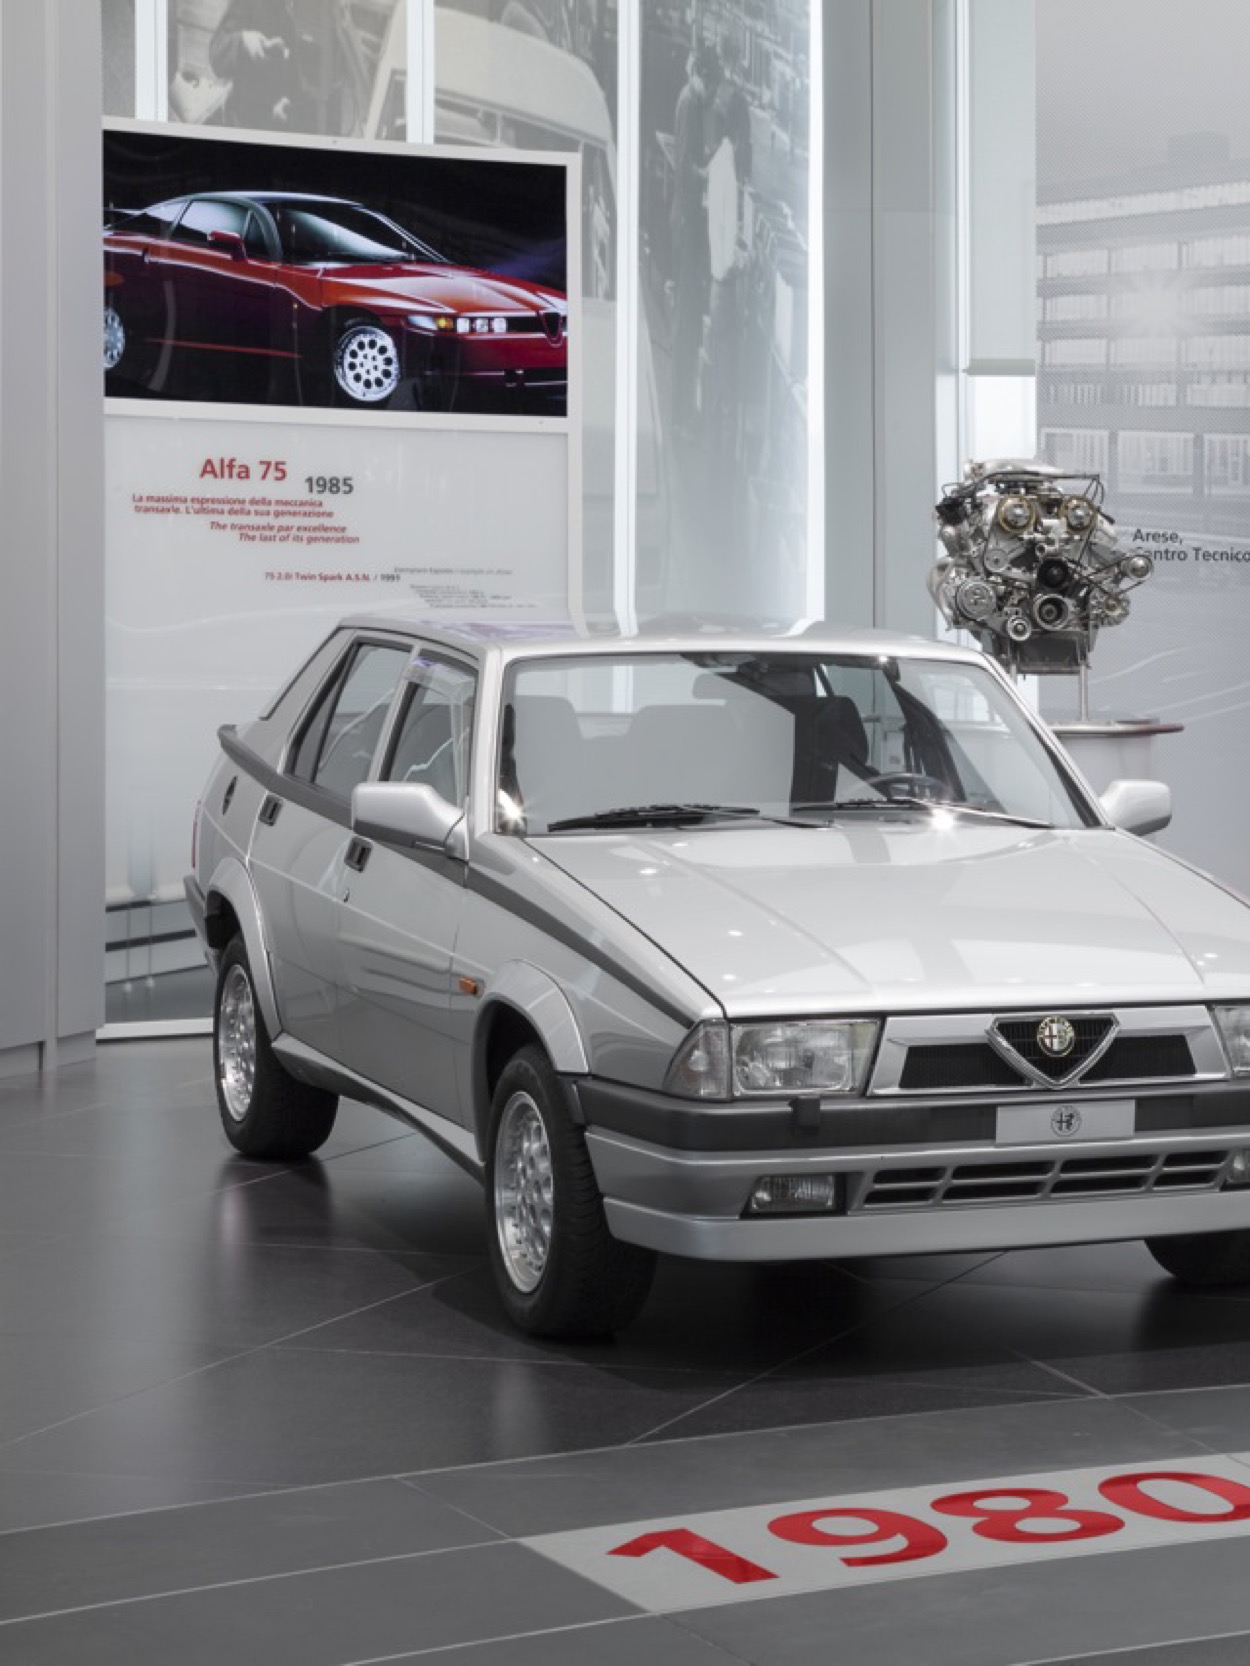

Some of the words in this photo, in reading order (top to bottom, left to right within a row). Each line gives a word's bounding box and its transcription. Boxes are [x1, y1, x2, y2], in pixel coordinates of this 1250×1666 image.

[200, 457, 250, 480] Alfa
[258, 460, 287, 481] 75
[304, 476, 354, 495] 1985
[132, 494, 143, 503] La
[146, 495, 188, 504] massima
[190, 496, 247, 507] espressione
[248, 498, 272, 507] della
[275, 499, 323, 508] meccanica
[227, 507, 251, 516] della
[253, 509, 271, 517] sua
[273, 509, 334, 519] generazione
[210, 521, 228, 531] The
[230, 522, 275, 532] transaxle
[277, 524, 294, 533] par
[296, 524, 347, 534] excellence
[239, 532, 257, 542] The
[259, 533, 277, 542] last
[279, 533, 291, 543] of
[306, 535, 360, 545] generation
[1133, 528, 1183, 545] Arese,
[1134, 547, 1189, 562] ntro
